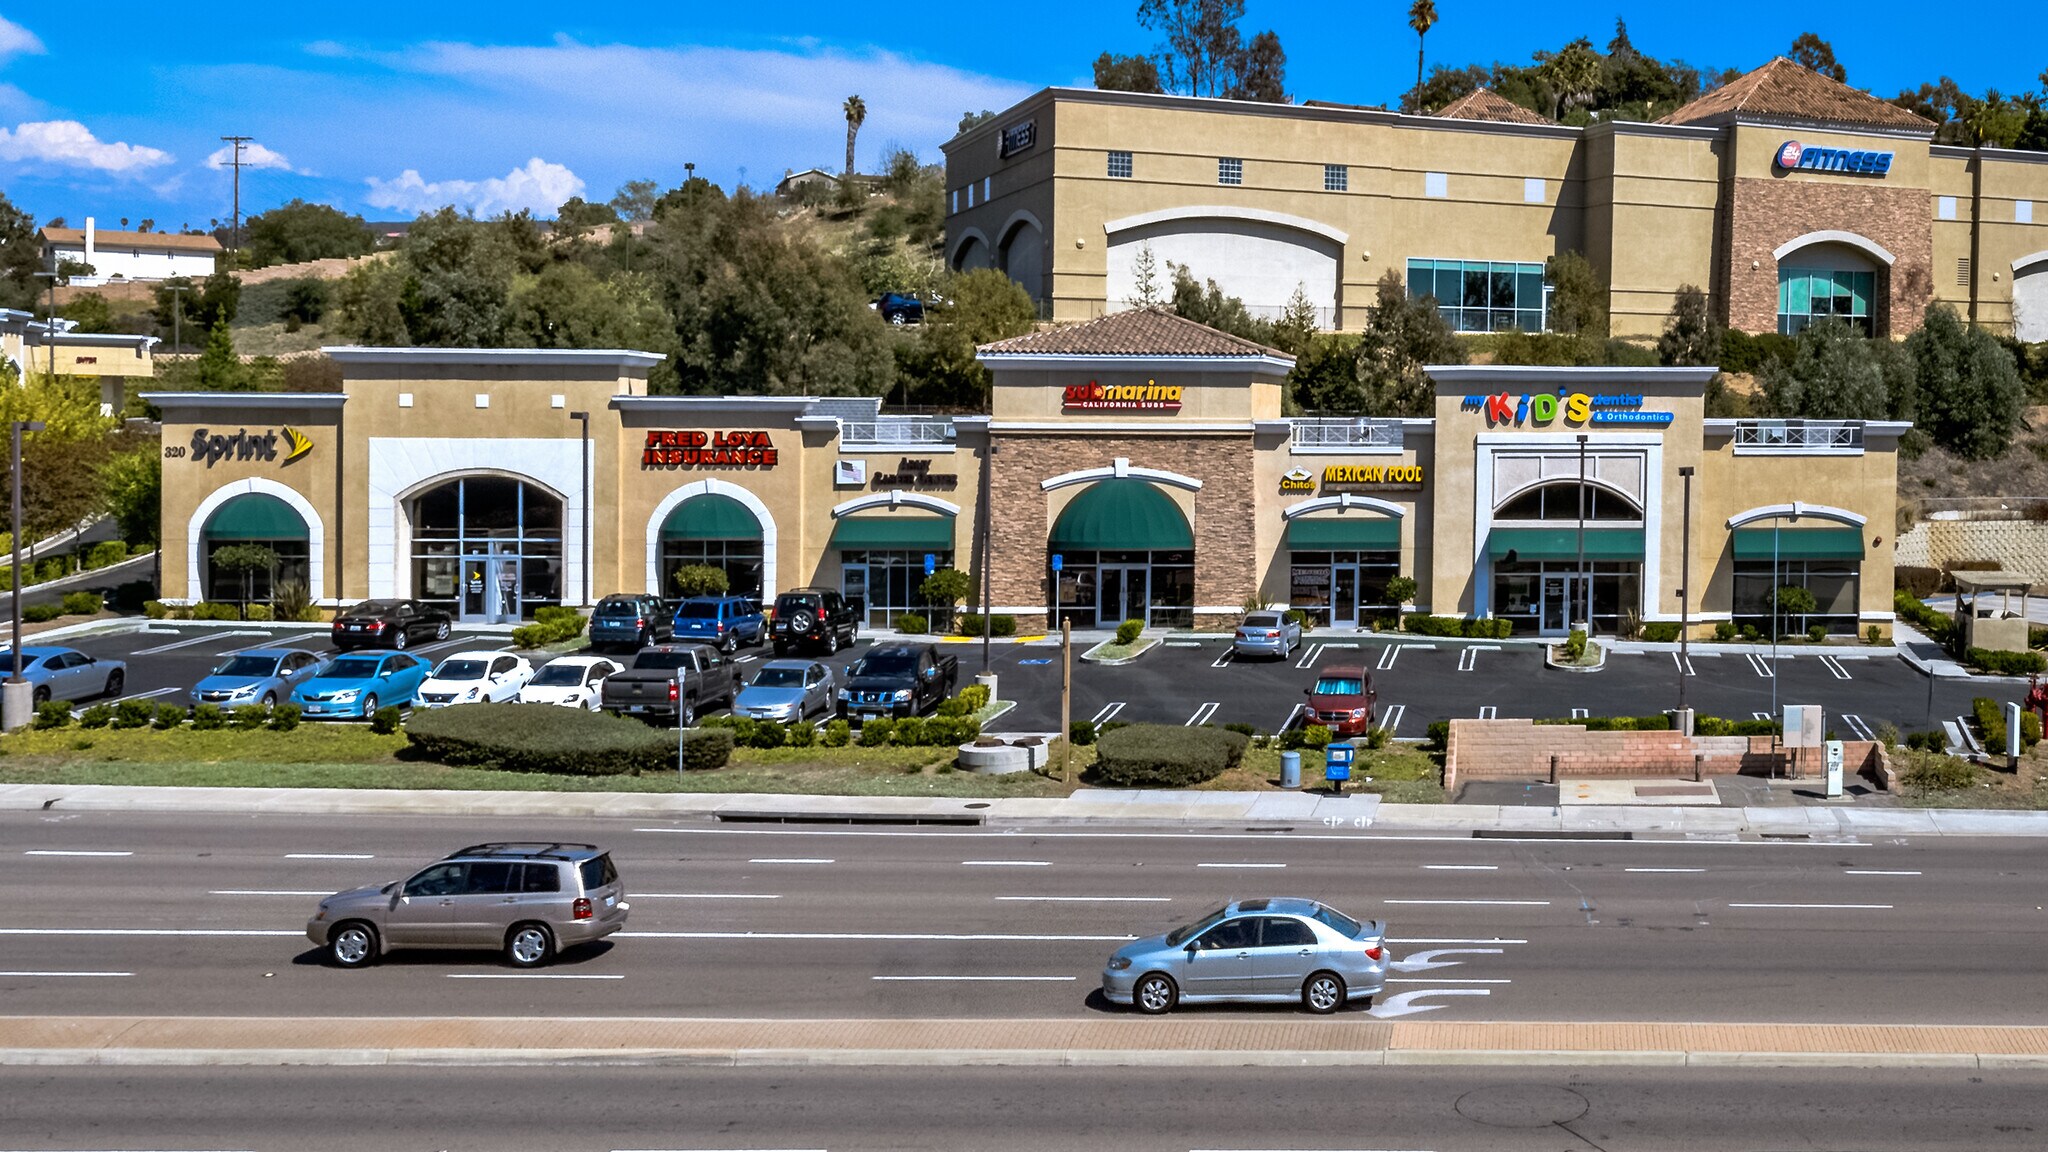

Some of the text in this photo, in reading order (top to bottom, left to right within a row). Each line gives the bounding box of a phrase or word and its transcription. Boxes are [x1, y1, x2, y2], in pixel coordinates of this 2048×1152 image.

[1783, 146, 1801, 158] 24
[1800, 148, 1893, 172] FITNESS
[1065, 379, 1183, 401] submarina
[1463, 394, 1486, 407] my
[1592, 393, 1644, 406] dentist
[1596, 412, 1671, 421] & Orthodontics
[647, 430, 773, 447] FRED LOYA
[164, 446, 186, 458] 320
[191, 428, 278, 467] Sprint
[643, 448, 778, 466] INSURANCE
[1324, 465, 1423, 482] MEXICAN FOOD
